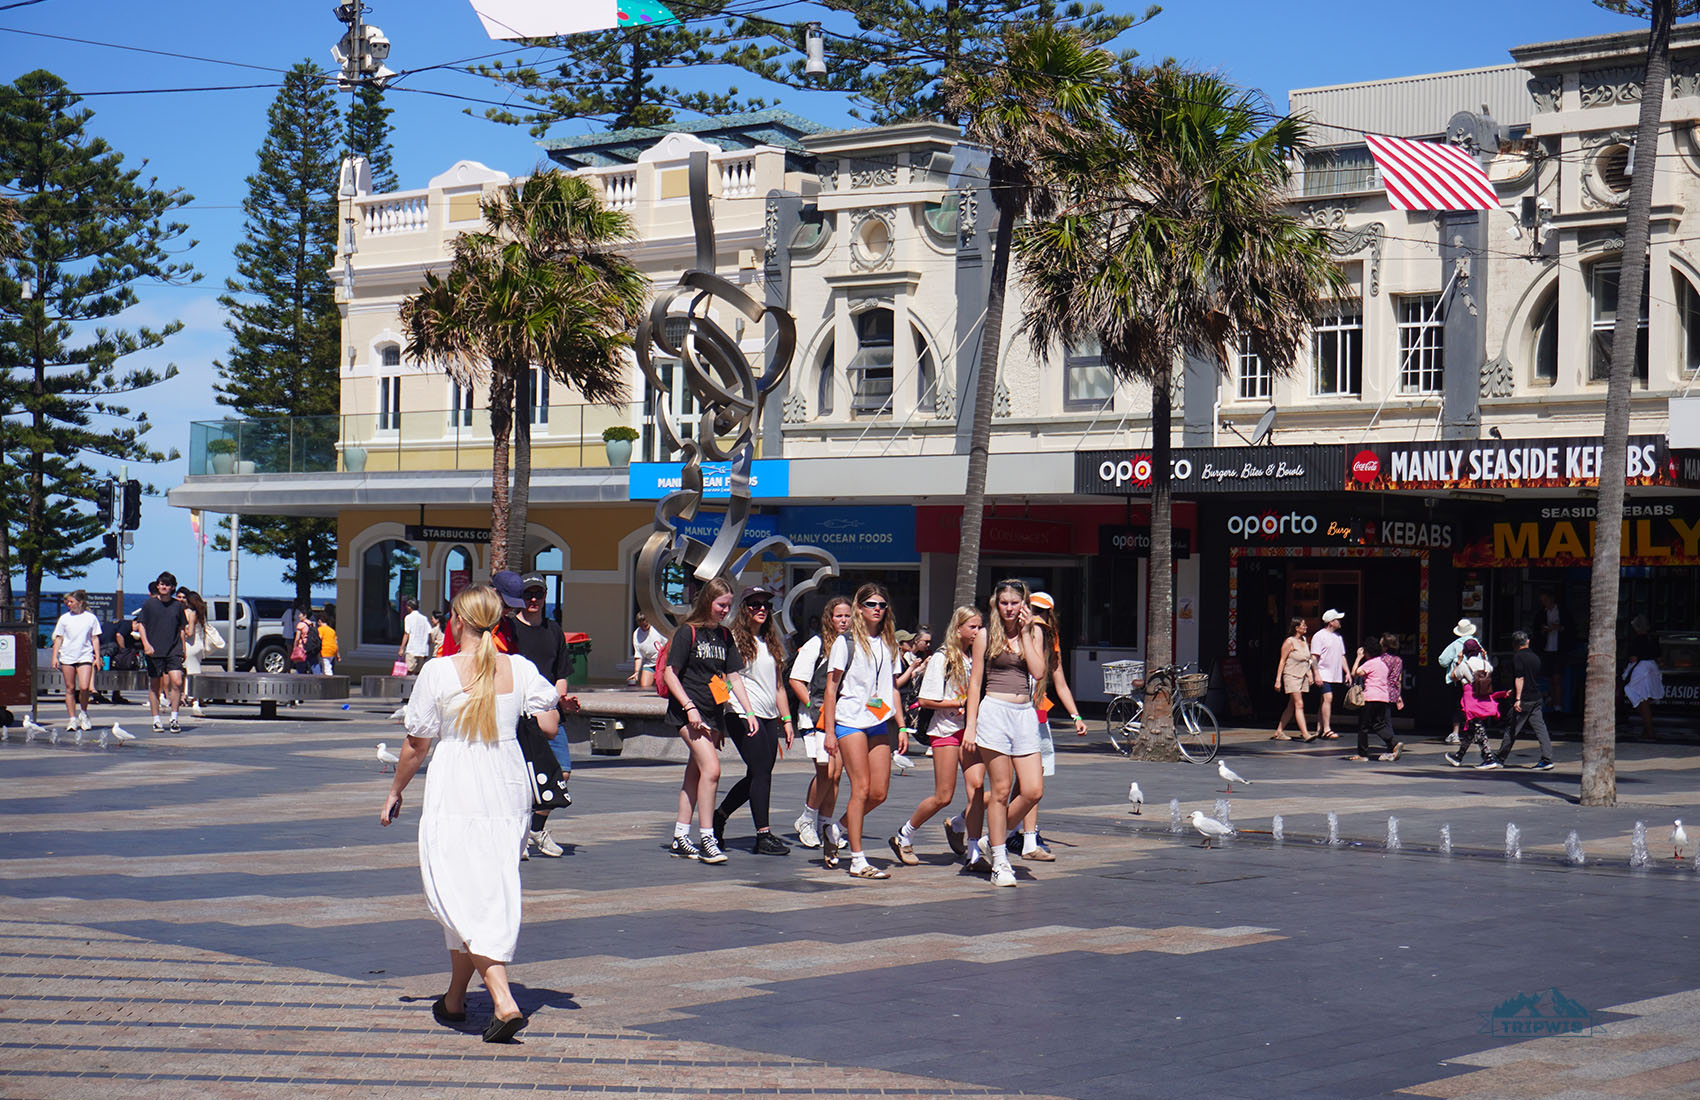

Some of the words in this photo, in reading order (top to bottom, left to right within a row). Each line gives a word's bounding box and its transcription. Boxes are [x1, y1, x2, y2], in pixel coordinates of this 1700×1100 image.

[1201, 463, 1239, 482] Burgers,
[1240, 462, 1264, 479] Bites
[1265, 463, 1276, 476] &
[1275, 461, 1305, 478] Bowls
[1391, 449, 1463, 482] MANLY
[1468, 447, 1559, 481] SEASIDE
[1565, 445, 1656, 480] KEBS
[1099, 459, 1193, 487] opoo
[702, 476, 723, 488] EAN
[1541, 506, 1597, 519] SEASID
[1622, 504, 1675, 517] EBABS
[422, 528, 476, 539] STARBUCKS
[684, 526, 712, 537] MANLY
[744, 529, 771, 539] FOODS
[1227, 511, 1318, 540] oporto
[789, 533, 820, 543] MANLY
[822, 533, 856, 543] OCEAN
[858, 533, 893, 543] FOODS
[1112, 532, 1149, 549] oporto
[1381, 520, 1452, 548] KEBABS
[1664, 684, 1700, 699] EASIDE
